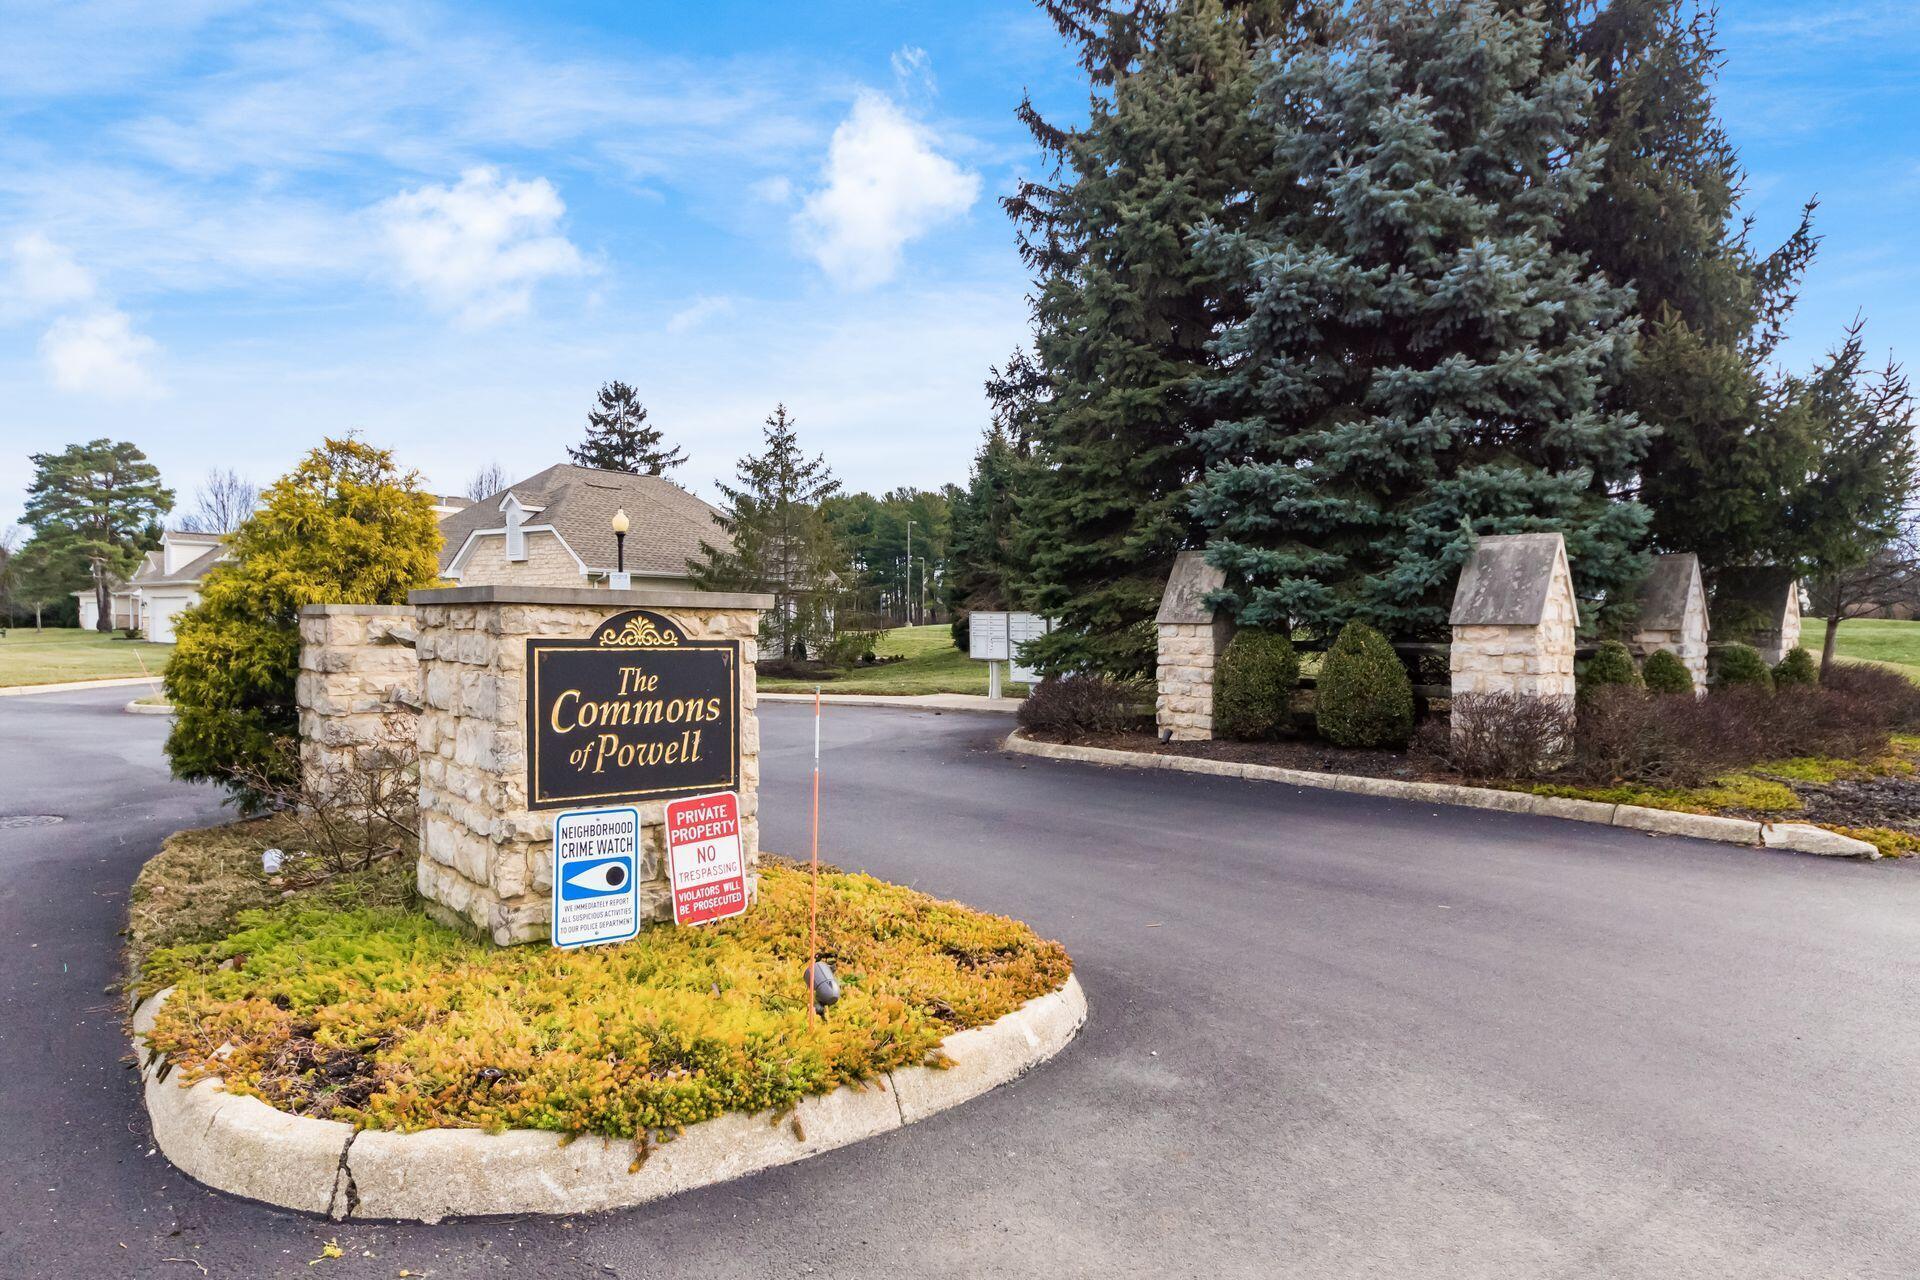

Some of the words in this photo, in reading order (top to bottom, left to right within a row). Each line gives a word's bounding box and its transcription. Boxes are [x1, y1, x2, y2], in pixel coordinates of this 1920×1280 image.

[618, 667, 658, 695] The
[551, 689, 721, 733] Commons
[569, 741, 594, 772] of
[592, 729, 702, 774] Powell
[676, 804, 728, 826] PRIVATE
[561, 821, 633, 839] NEIGHBORHOOD
[671, 819, 736, 844] PROPERTY
[561, 841, 594, 859] CRIME
[596, 837, 633, 855] WATCH
[697, 845, 716, 864] NO
[679, 862, 738, 883] TRESPASSING
[678, 885, 720, 903] VIOLATORS
[723, 881, 741, 893] WILL
[574, 901, 608, 911] IMMEDIATELY
[609, 897, 629, 907] REPORT
[680, 904, 690, 915] BE
[693, 892, 742, 912] PROSECUTED
[568, 925, 579, 933] OUR
[580, 922, 598, 931] POLICE
[599, 917, 633, 929] DEPARTMENT
[572, 911, 604, 922] SUSPICIOUS
[604, 908, 632, 917] ACTIVITIES
